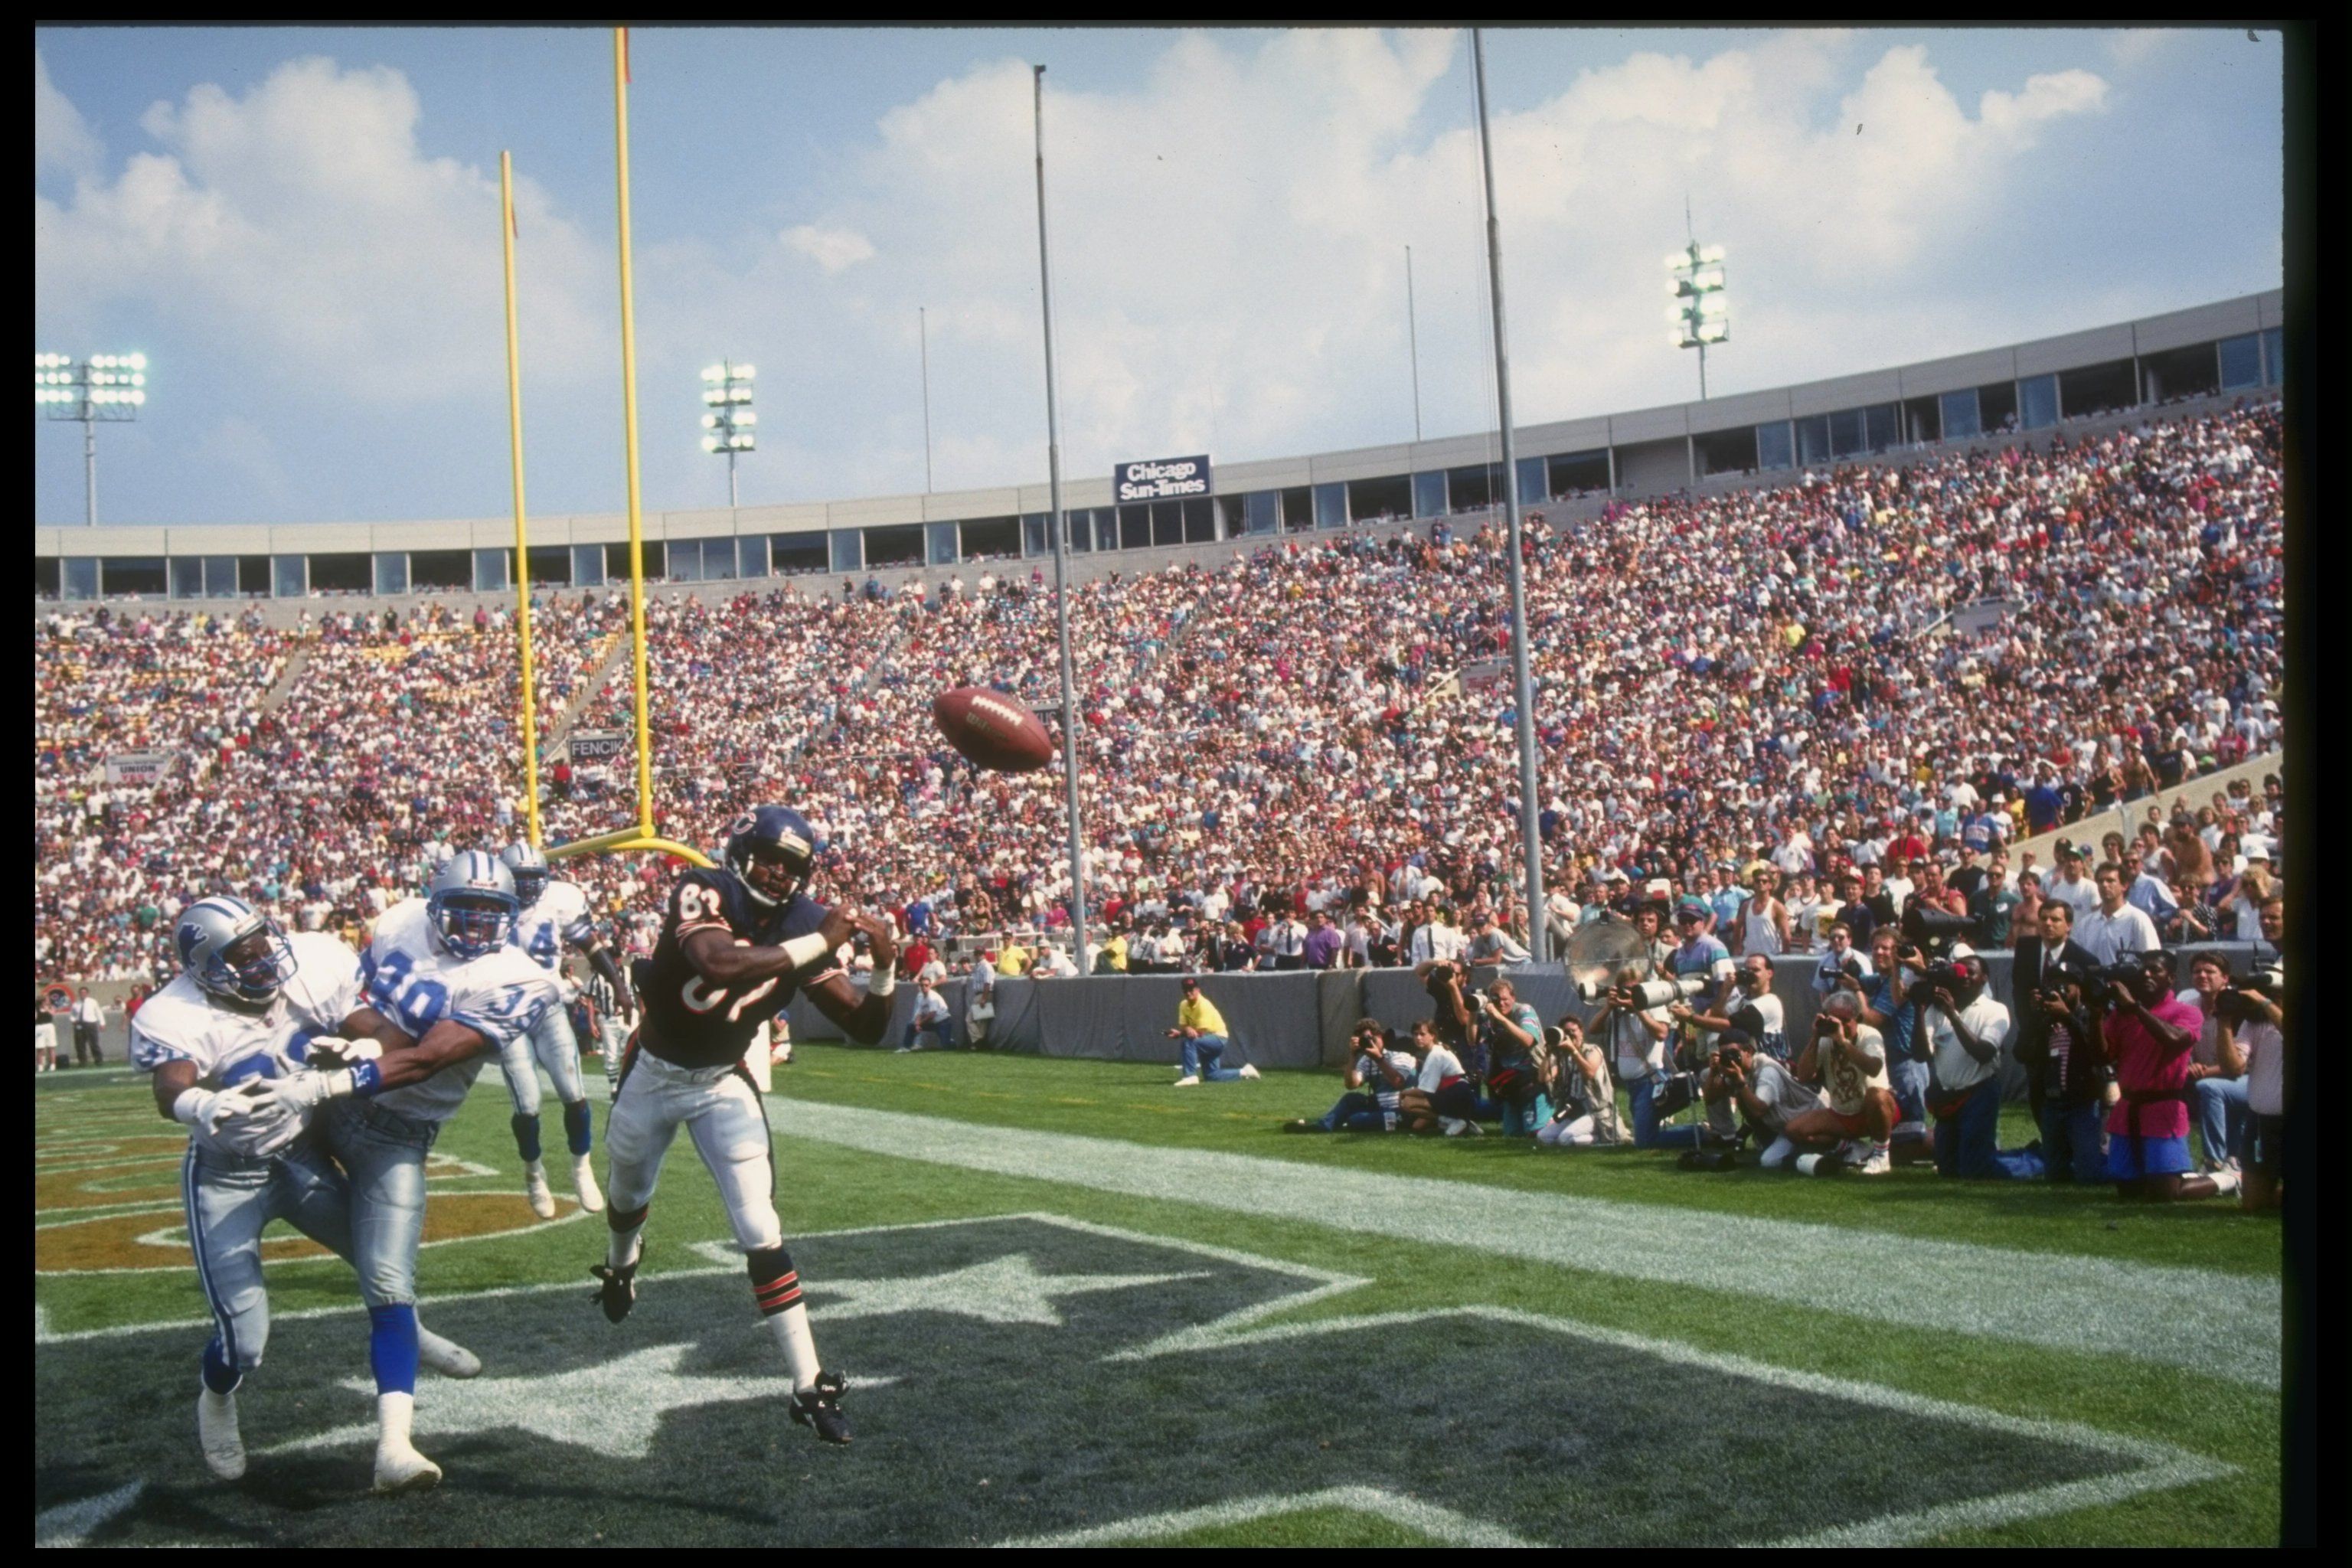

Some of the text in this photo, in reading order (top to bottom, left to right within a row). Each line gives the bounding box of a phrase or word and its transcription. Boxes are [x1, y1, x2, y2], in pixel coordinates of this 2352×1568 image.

[1127, 462, 1196, 481] Chicago
[1120, 479, 1205, 499] Sun-Times
[571, 740, 623, 756] FENCIK
[119, 765, 156, 773] UNION
[732, 812, 756, 835] C
